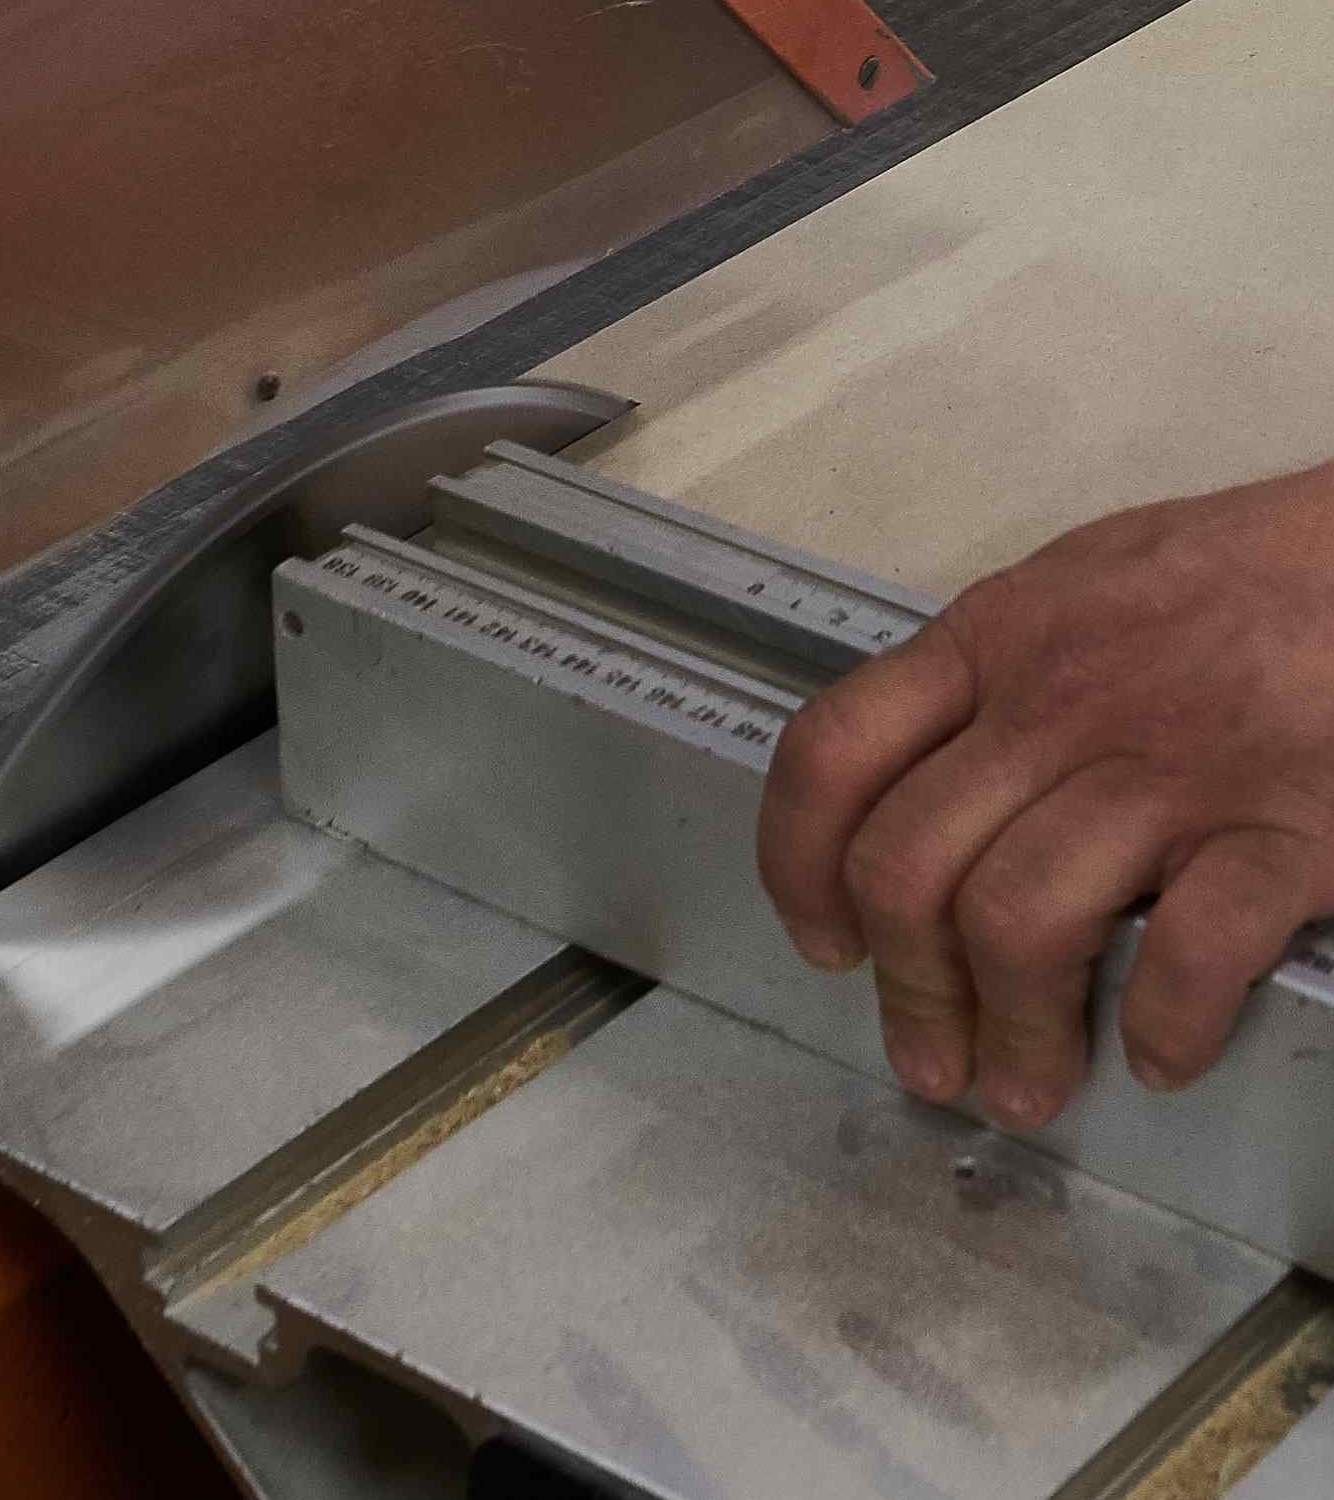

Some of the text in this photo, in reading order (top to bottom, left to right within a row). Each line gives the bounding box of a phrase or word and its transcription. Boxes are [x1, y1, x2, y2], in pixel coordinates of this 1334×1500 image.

[398, 590, 438, 612] 140
[443, 607, 479, 627] 141
[479, 622, 518, 643] 142
[559, 654, 599, 676] 144
[687, 705, 728, 728] 147
